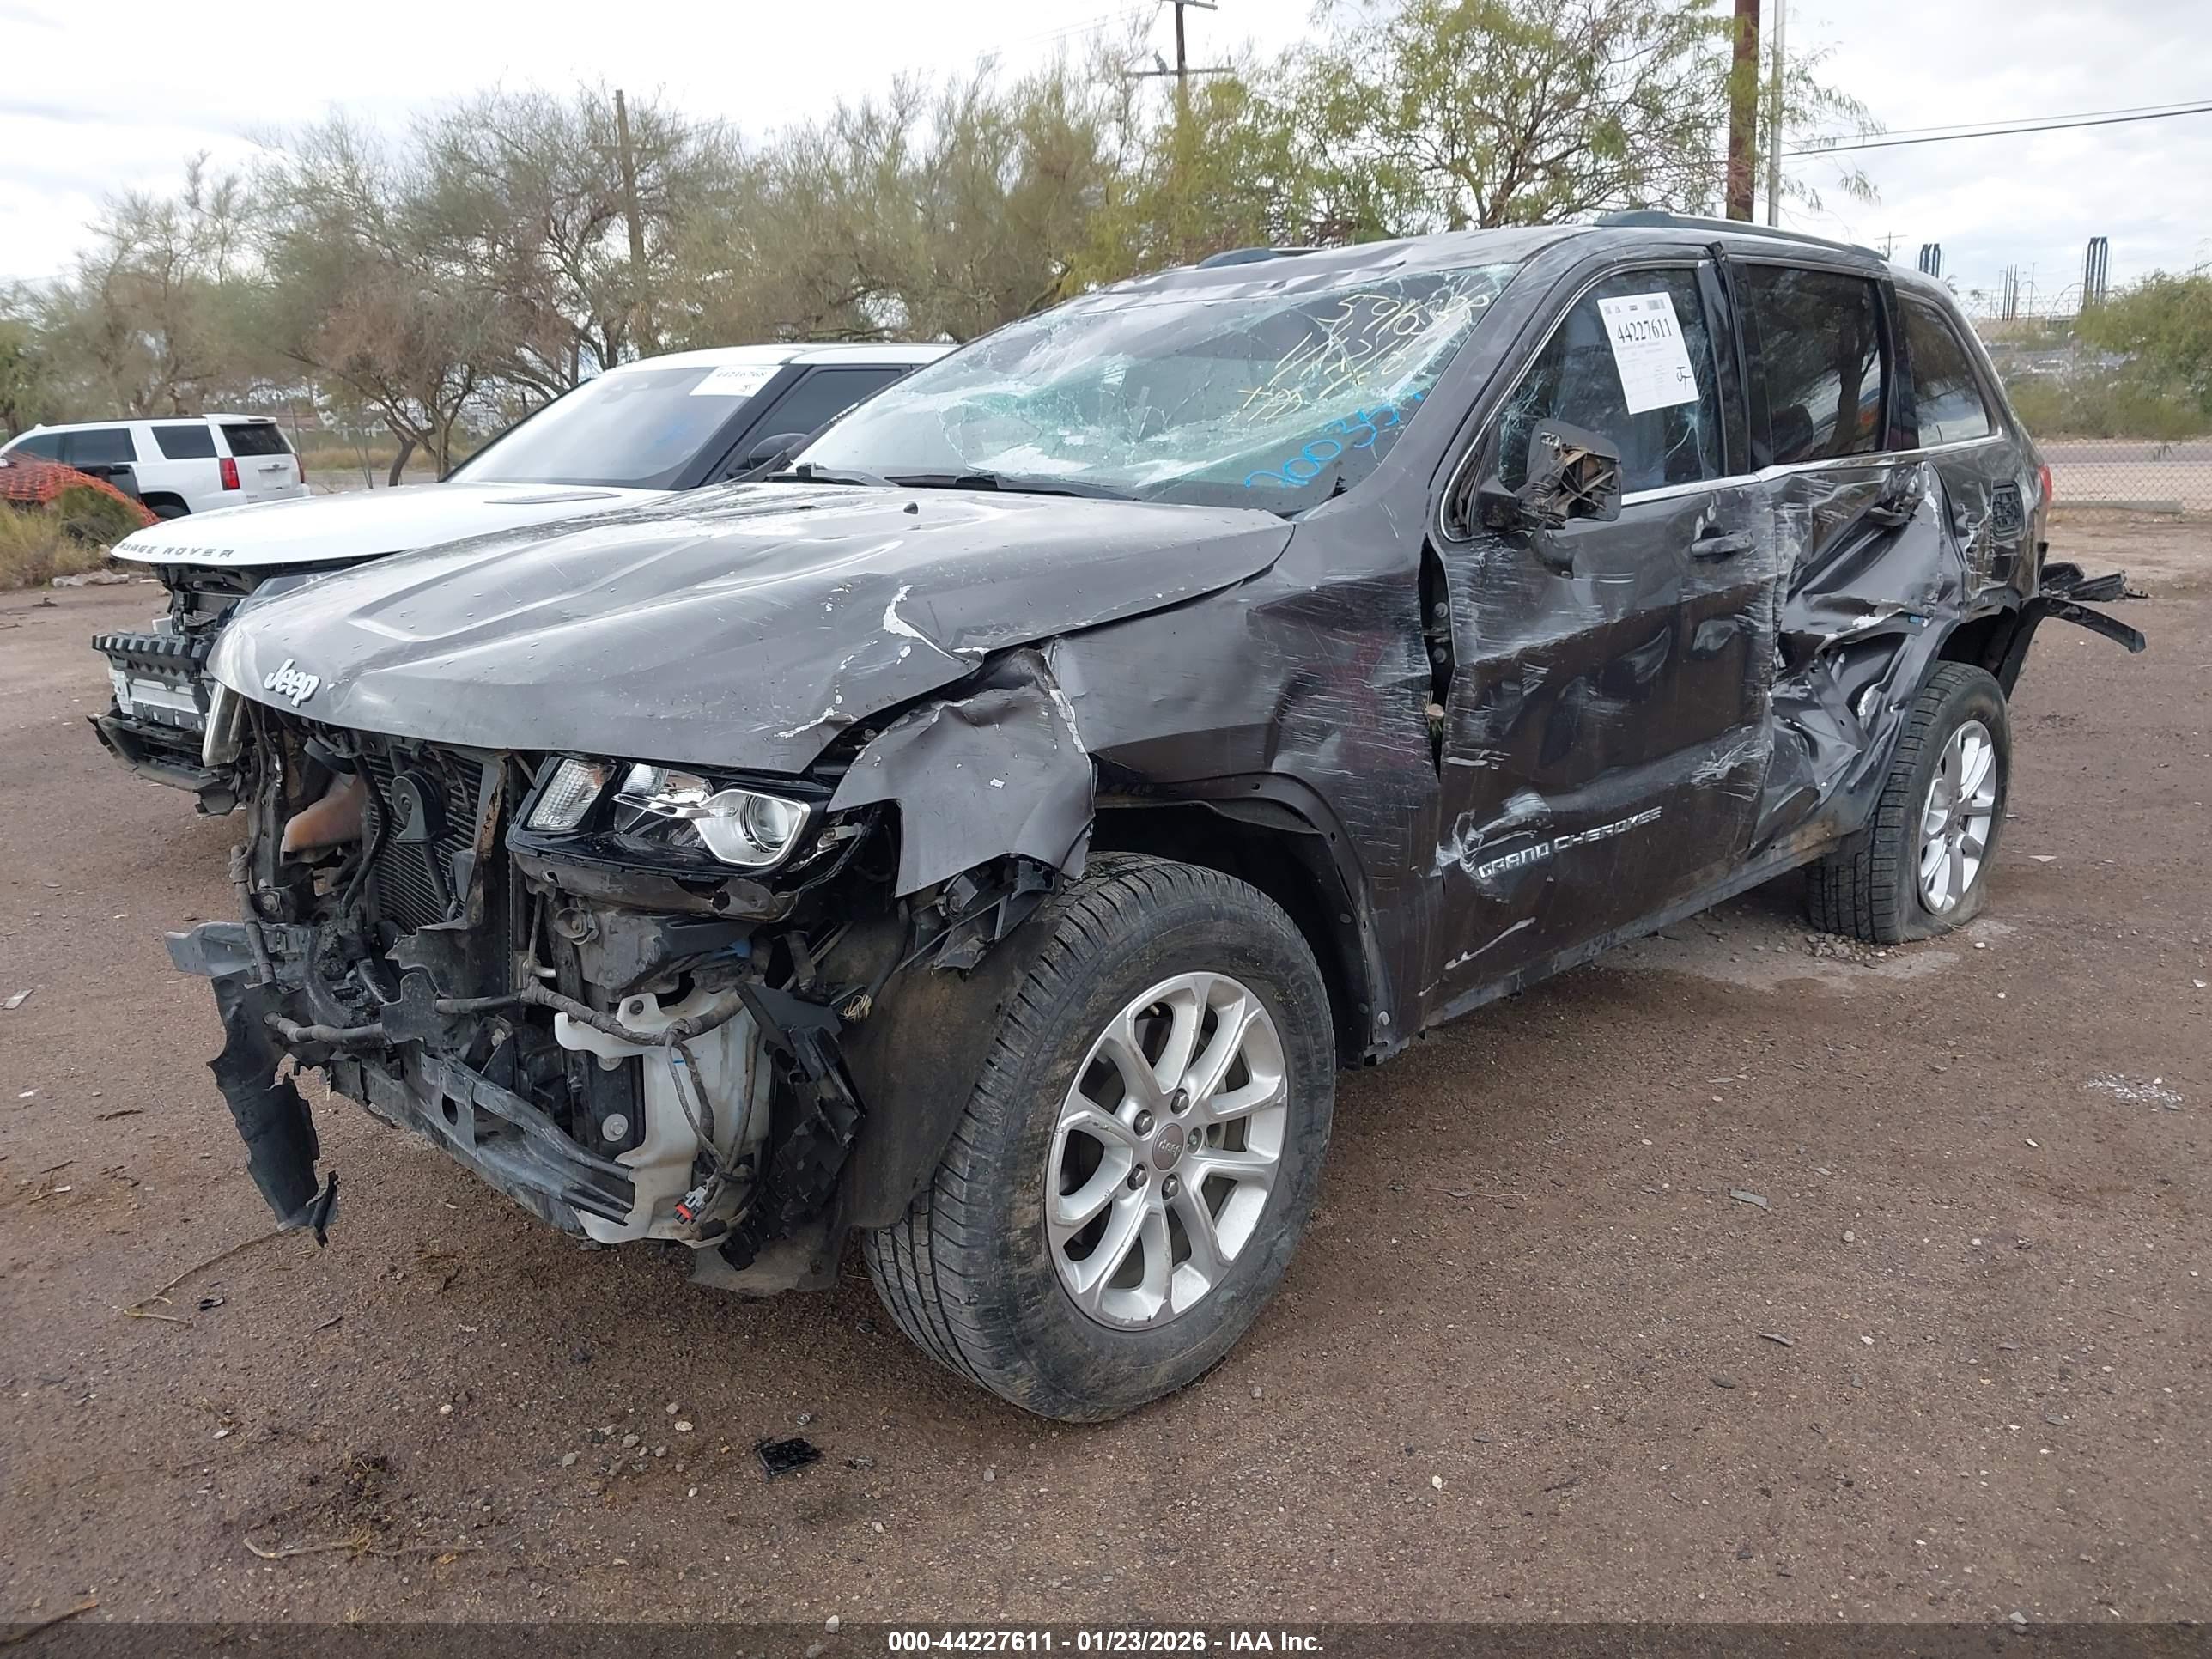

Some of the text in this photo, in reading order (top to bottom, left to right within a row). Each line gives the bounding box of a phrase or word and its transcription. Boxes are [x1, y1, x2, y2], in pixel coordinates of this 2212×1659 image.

[1617, 317, 1673, 344] 44227611
[162, 547, 234, 558] ROVER
[264, 659, 319, 708] Jeep
[1478, 805, 1663, 879] GRAND CHEROKEE
